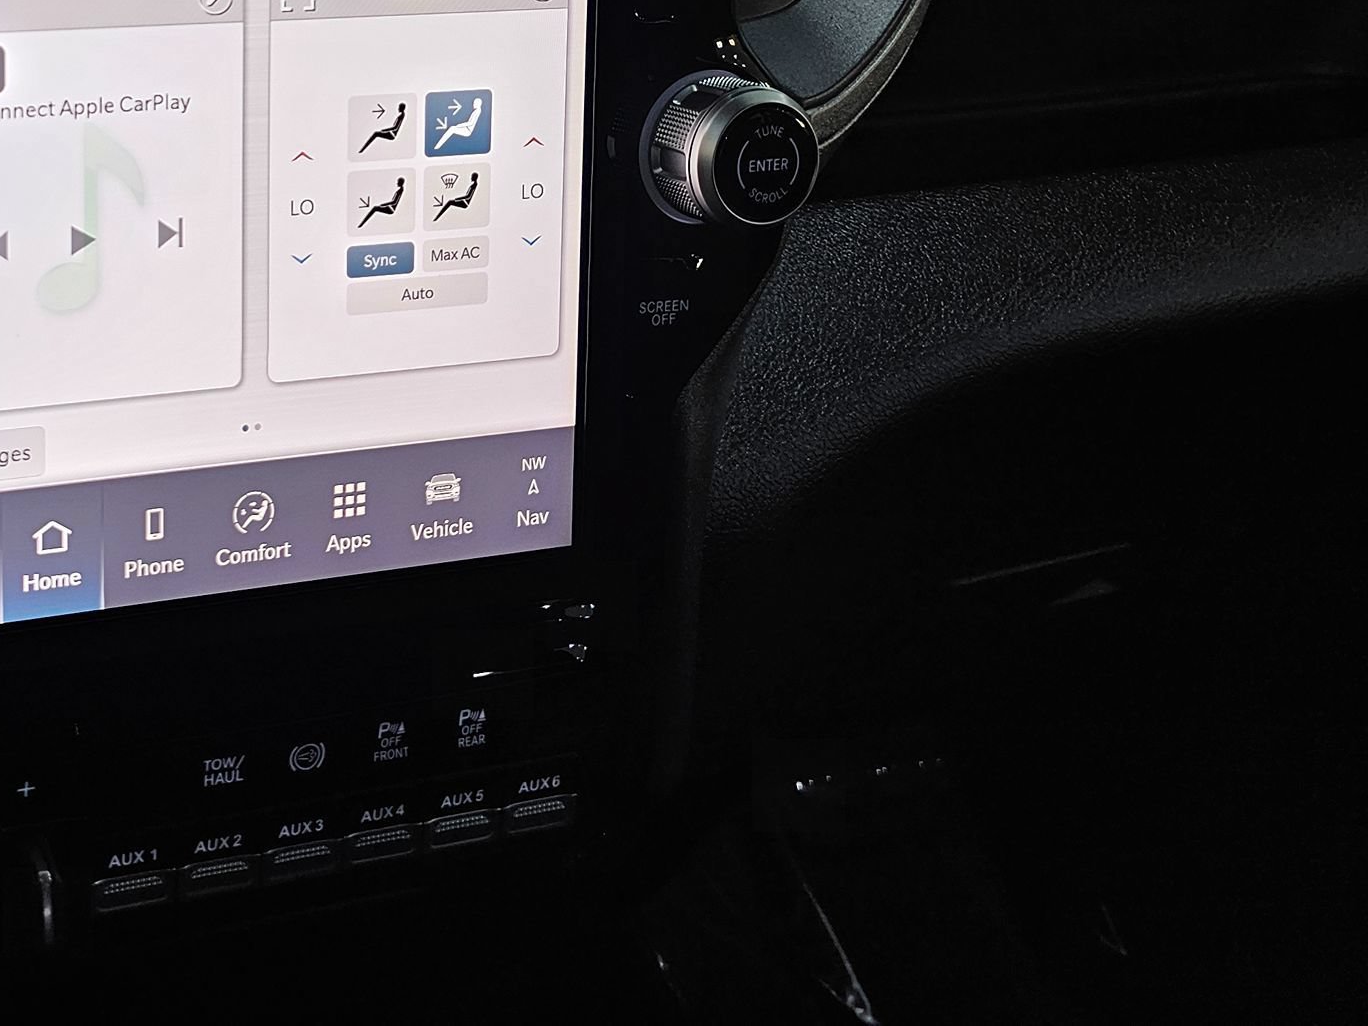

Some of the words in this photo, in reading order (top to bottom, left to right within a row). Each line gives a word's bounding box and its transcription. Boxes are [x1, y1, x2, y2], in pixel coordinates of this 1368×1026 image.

[59, 97, 115, 118] Apple
[119, 93, 191, 115] CarPlay
[754, 125, 785, 139] TUNE
[748, 157, 789, 173] ENTER
[521, 183, 544, 200] LO
[748, 186, 789, 204] SCROLL
[290, 199, 315, 217] LO
[363, 253, 399, 271] Sync
[431, 248, 459, 262] Max
[461, 246, 480, 260] AC
[401, 287, 434, 302] Auto
[639, 299, 690, 315] SCREEN
[650, 312, 677, 327] OFF
[521, 456, 547, 472] NW
[516, 509, 550, 528] Nav
[410, 517, 474, 541] Vehicle
[325, 532, 372, 555] Apps
[215, 541, 292, 566] Comfort
[124, 556, 185, 579] Phone
[22, 569, 82, 593] Home
[461, 724, 483, 736] OFF
[380, 735, 402, 748] OFF
[457, 734, 486, 748] REAR
[203, 754, 246, 772] TOW/
[373, 746, 409, 762] FRONT
[204, 769, 245, 787] HAUL
[518, 776, 551, 794] AUX
[551, 775, 561, 789] 6
[440, 791, 474, 809] AUX
[475, 789, 485, 803] 5
[360, 805, 394, 823] AUX
[395, 803, 406, 816] 4
[278, 820, 313, 839] AUX
[314, 818, 324, 832] 3
[194, 836, 230, 854] AUX
[231, 834, 242, 848] 2
[108, 849, 145, 869] AUX
[149, 848, 158, 861] 1
